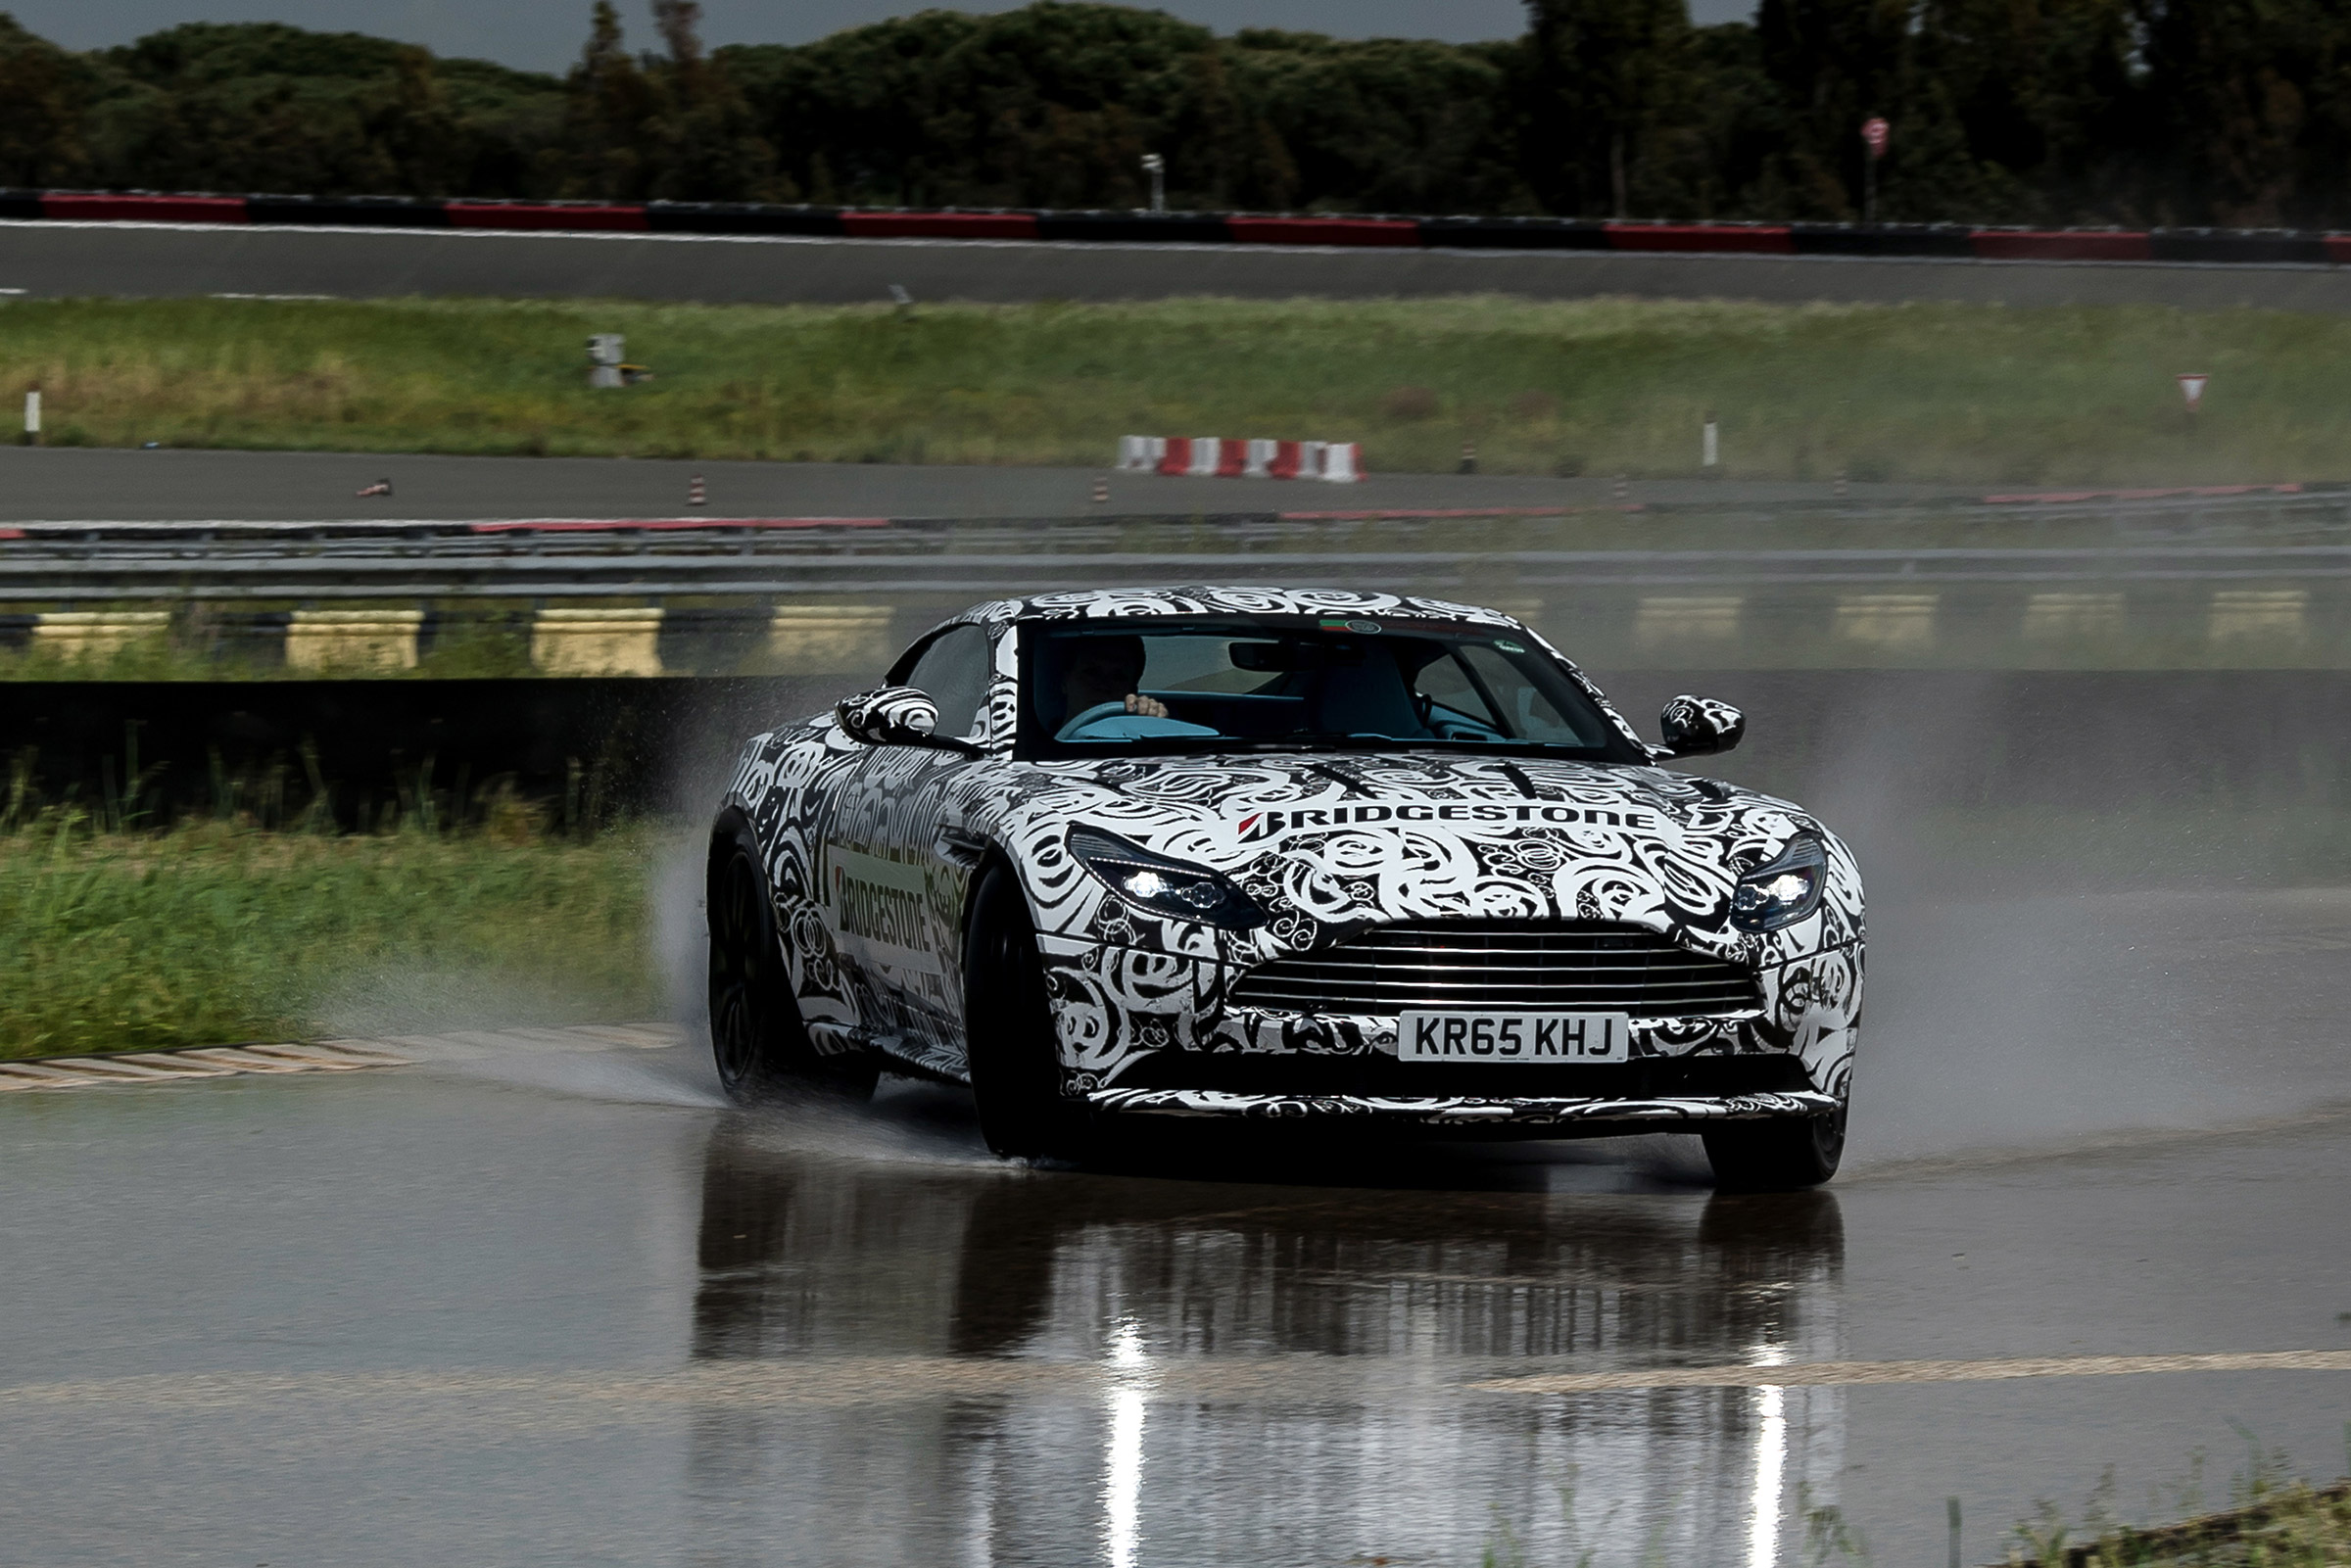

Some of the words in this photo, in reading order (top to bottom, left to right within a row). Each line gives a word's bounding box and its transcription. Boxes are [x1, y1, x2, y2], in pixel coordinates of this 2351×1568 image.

[1238, 805, 1656, 844] BRIDGESTONE
[836, 866, 930, 952] BRIDGESTONE
[1415, 1017, 1523, 1056] KR65
[1534, 1018, 1612, 1056] KHJ
